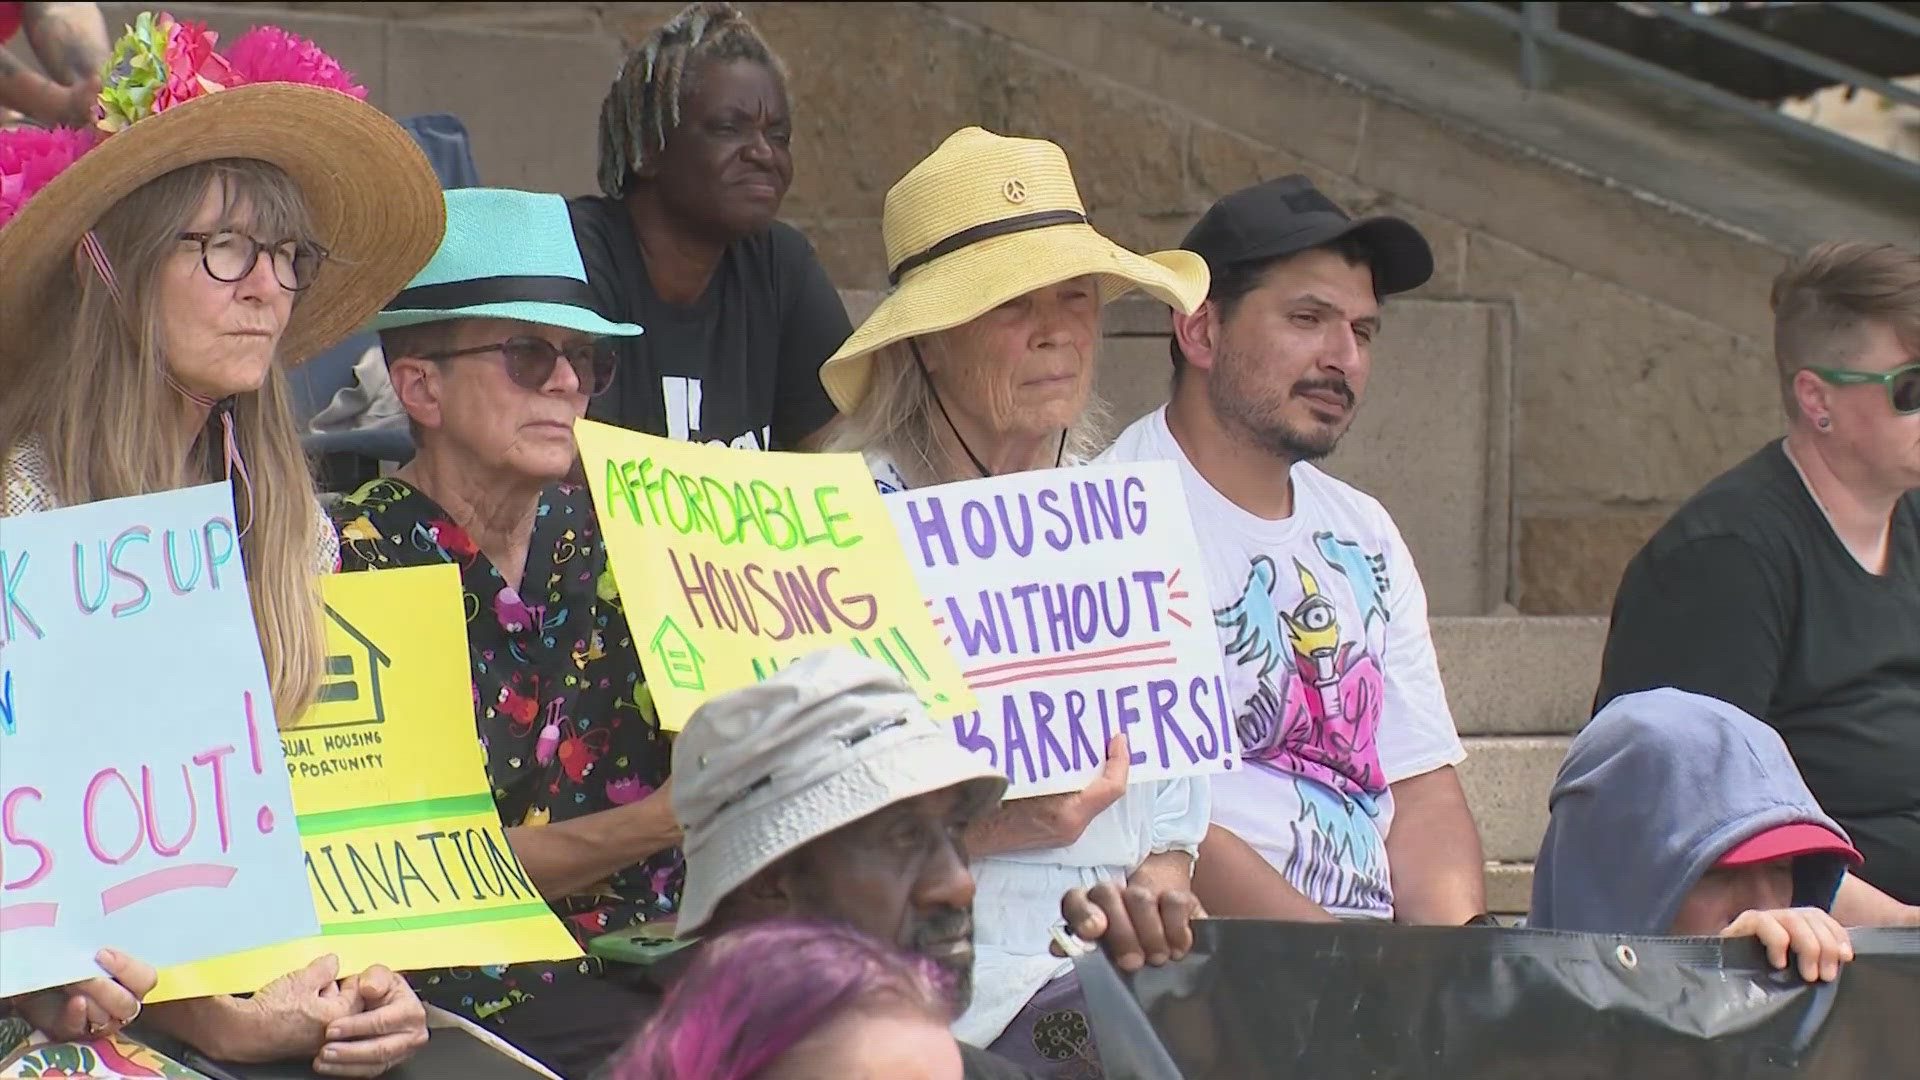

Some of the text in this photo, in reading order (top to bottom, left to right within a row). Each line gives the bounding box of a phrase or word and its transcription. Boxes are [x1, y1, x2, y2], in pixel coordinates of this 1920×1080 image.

[605, 457, 863, 551] AFFORDABLE
[906, 476, 1148, 568] HOUSING
[0, 515, 234, 645] K US UP
[667, 547, 878, 642] HOUSING
[945, 570, 1166, 657] WITHOUT
[323, 731, 382, 753] HOUSING
[952, 674, 1234, 786] BARRIERS!
[0, 785, 54, 891] S
[82, 690, 275, 866] OUT!
